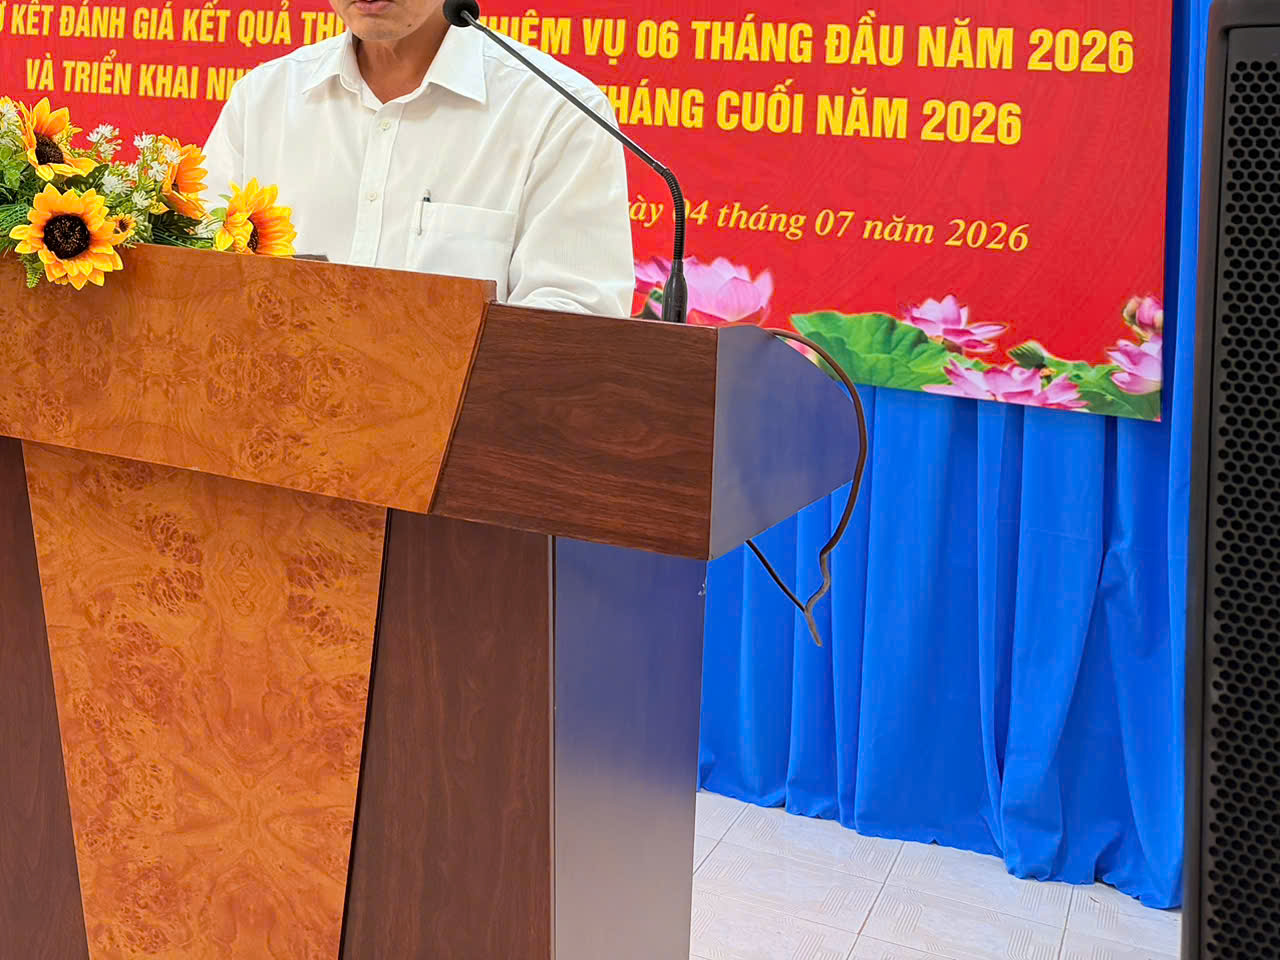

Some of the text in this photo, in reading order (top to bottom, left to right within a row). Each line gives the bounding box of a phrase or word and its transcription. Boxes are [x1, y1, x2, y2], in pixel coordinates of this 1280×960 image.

[58, 0, 127, 40] ĐÁNH
[132, 0, 175, 41] GIÁ
[181, 0, 232, 43] KẾT
[237, 0, 292, 48] QUẢ
[583, 17, 627, 66] VỤ
[636, 19, 680, 60] 06
[690, 12, 814, 64] THÁNG
[824, 9, 905, 67] ĐẦU
[917, 17, 1015, 70] NĂM
[1027, 28, 1134, 74] 2026
[26, 52, 55, 92] VÀ
[63, 49, 133, 96] TRIỂN
[138, 63, 200, 100] KHAI
[716, 79, 805, 135] CUỐI
[815, 87, 909, 140] NĂM
[920, 99, 1023, 145] 2026
[717, 201, 807, 241] tháng
[815, 208, 855, 237] 07
[863, 215, 935, 245] năm
[944, 219, 1029, 252] 2026
